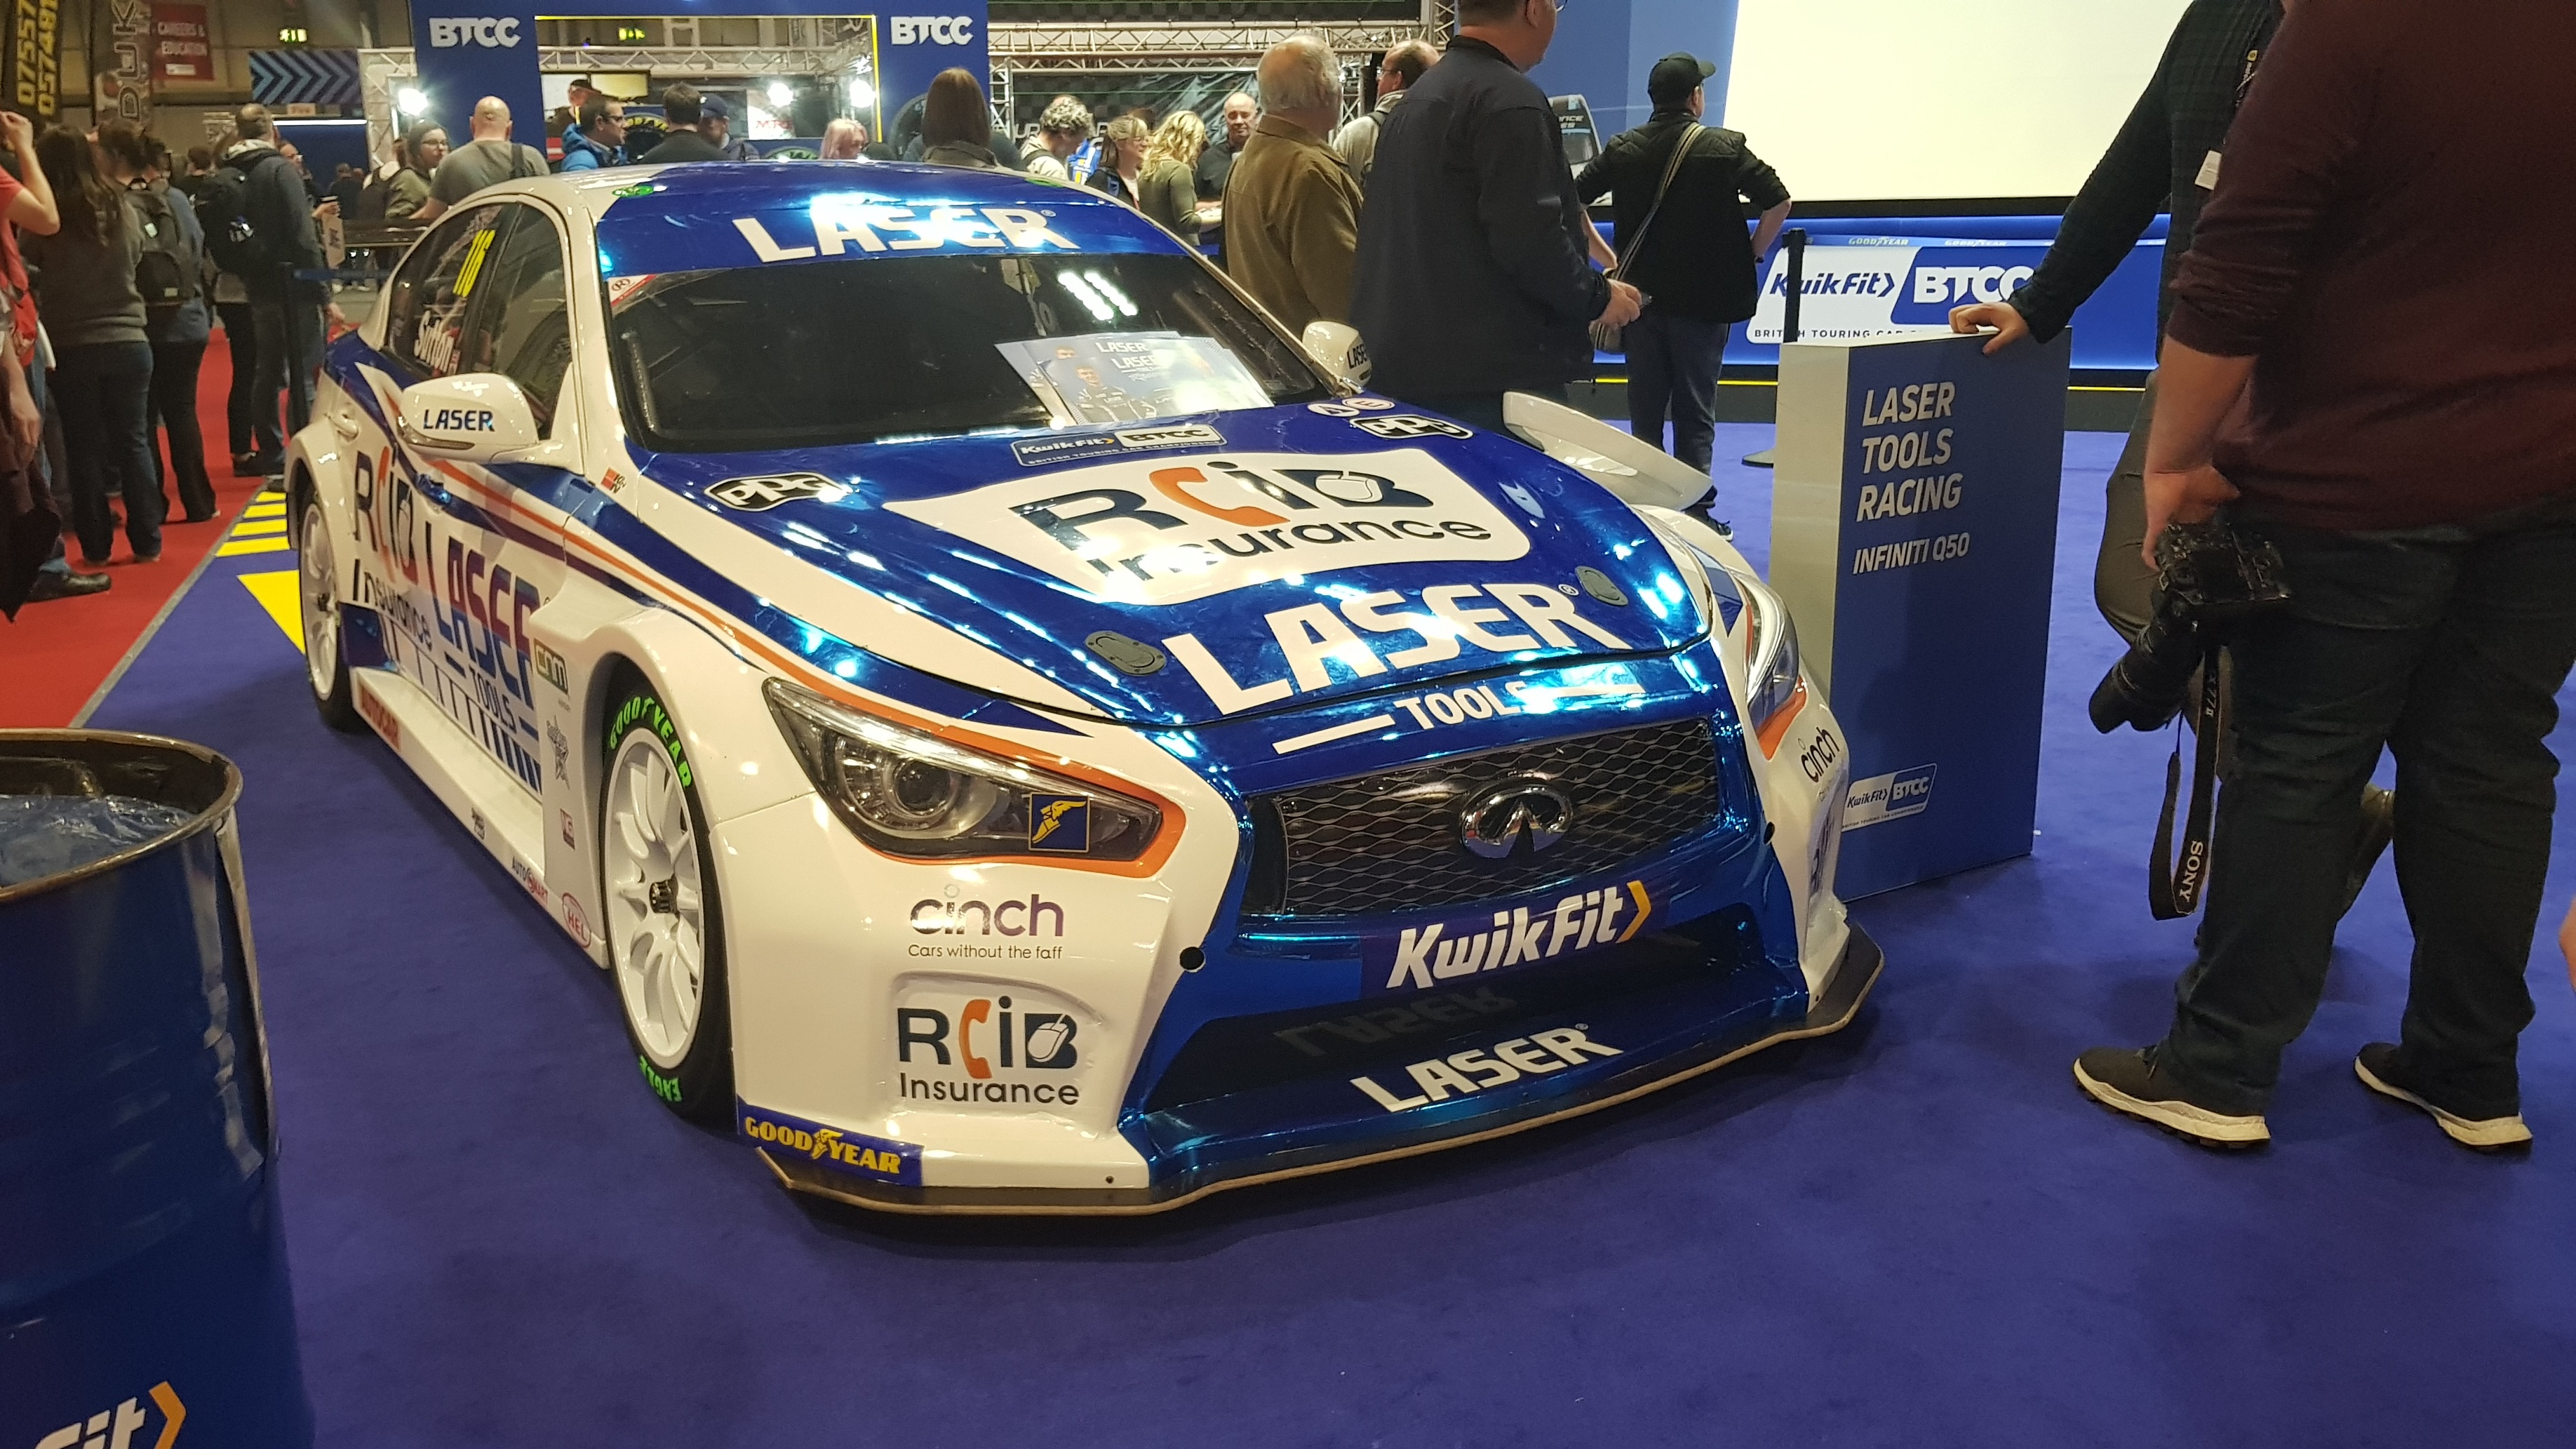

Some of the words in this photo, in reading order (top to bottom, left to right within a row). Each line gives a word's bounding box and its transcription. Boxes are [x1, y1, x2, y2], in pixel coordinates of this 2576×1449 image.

[429, 17, 521, 48] BTCC
[890, 15, 974, 46] BTCC
[732, 206, 1079, 262] LASER
[1848, 236, 1909, 246] GOODYEAR
[1914, 266, 2034, 303] BTCC
[1095, 342, 1149, 352] LASER
[423, 409, 495, 432] LASER
[1863, 382, 1955, 425] LASER
[1122, 429, 1210, 441] BTCC
[1362, 418, 1461, 434] PPG
[1862, 428, 1954, 474] TOOLS
[1856, 474, 1963, 521] RACING
[1852, 537, 1931, 574] INFINITI
[1932, 532, 1971, 562] Q50
[1160, 584, 1633, 716] LASER
[610, 696, 692, 788] GOODYEAR
[1801, 727, 1840, 783] cinch
[1893, 777, 1929, 800] BTCC
[2180, 841, 2203, 902] SONY
[568, 910, 587, 942] HEL
[910, 894, 1064, 937] cinch
[908, 944, 943, 957] Cars
[947, 944, 1002, 958] without
[1008, 945, 1031, 958] the
[1035, 946, 1062, 959] faff
[900, 1072, 1080, 1105] Insurance
[1350, 1026, 1623, 1113] LASER
[745, 1117, 900, 1175] GOODYEAR
